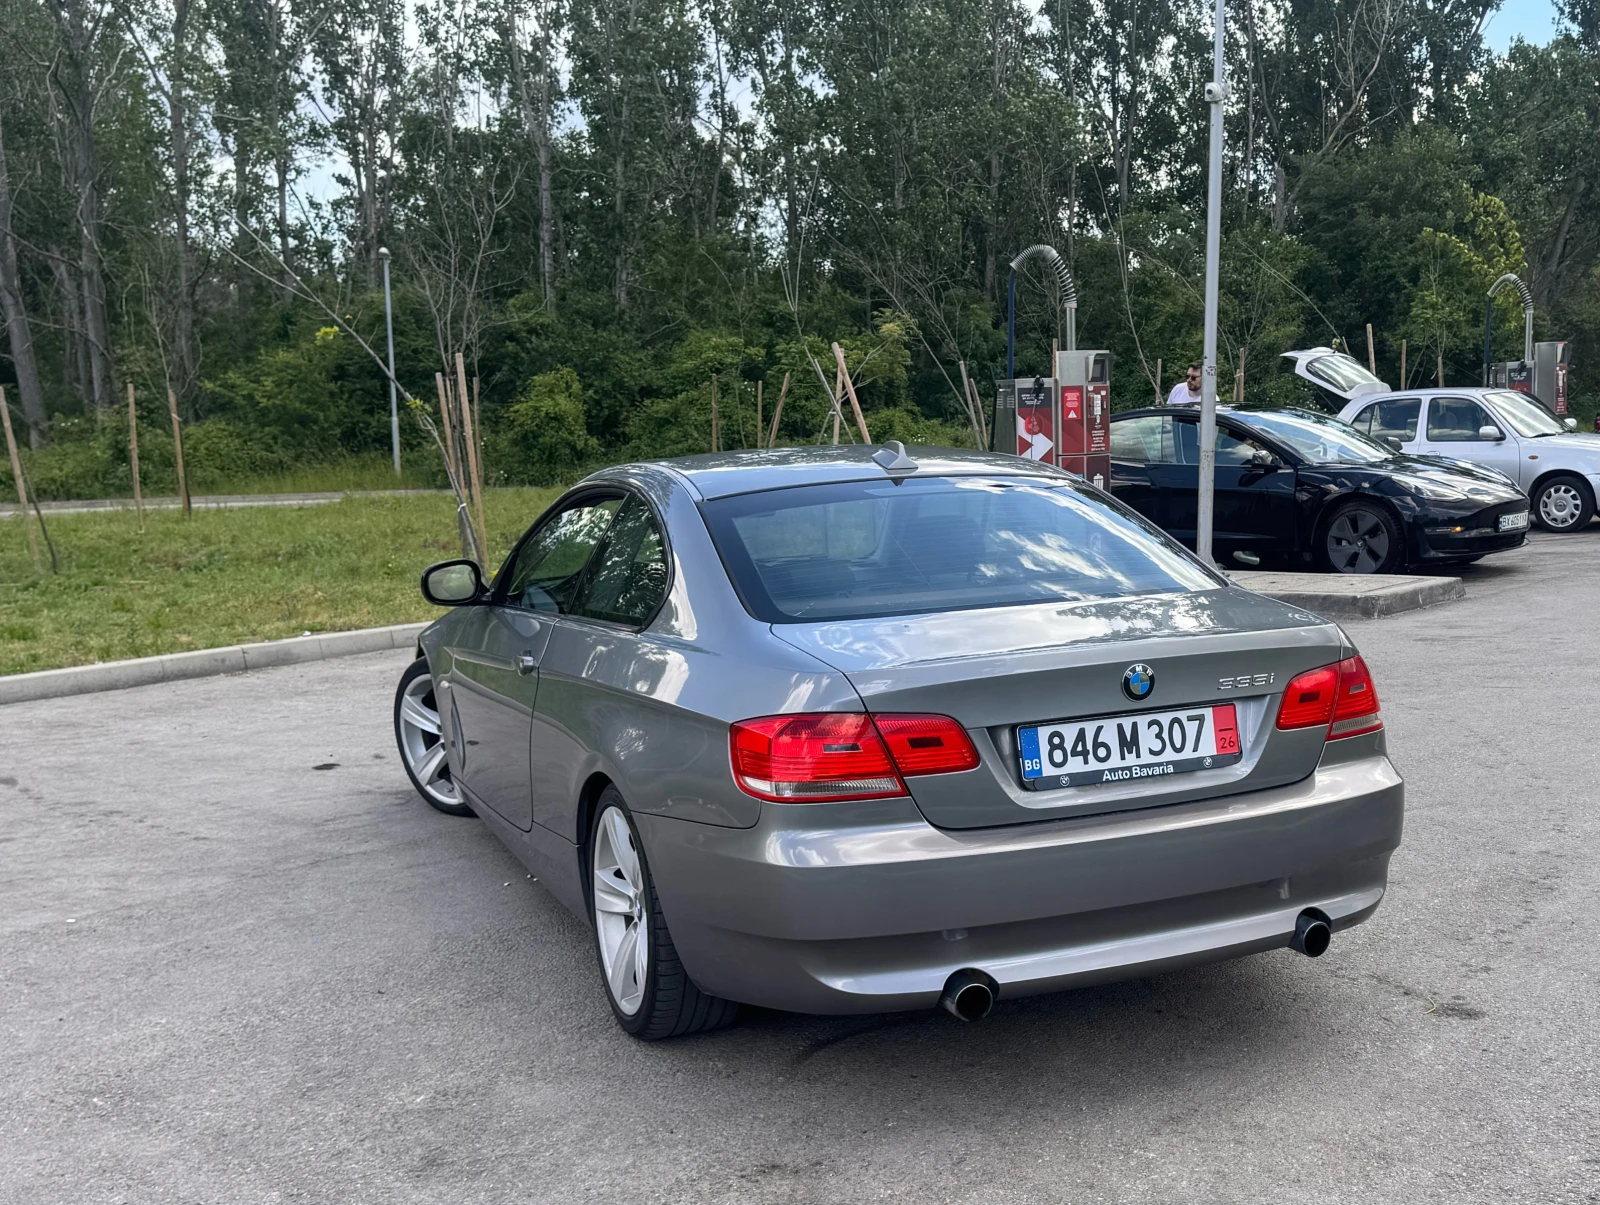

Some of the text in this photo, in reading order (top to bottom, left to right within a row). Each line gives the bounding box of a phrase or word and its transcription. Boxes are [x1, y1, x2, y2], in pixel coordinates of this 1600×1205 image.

[1126, 665, 1153, 679] BMW
[1220, 735, 1235, 749] 26
[1024, 758, 1041, 771] BG
[1102, 763, 1174, 782] Auto Bavaria
